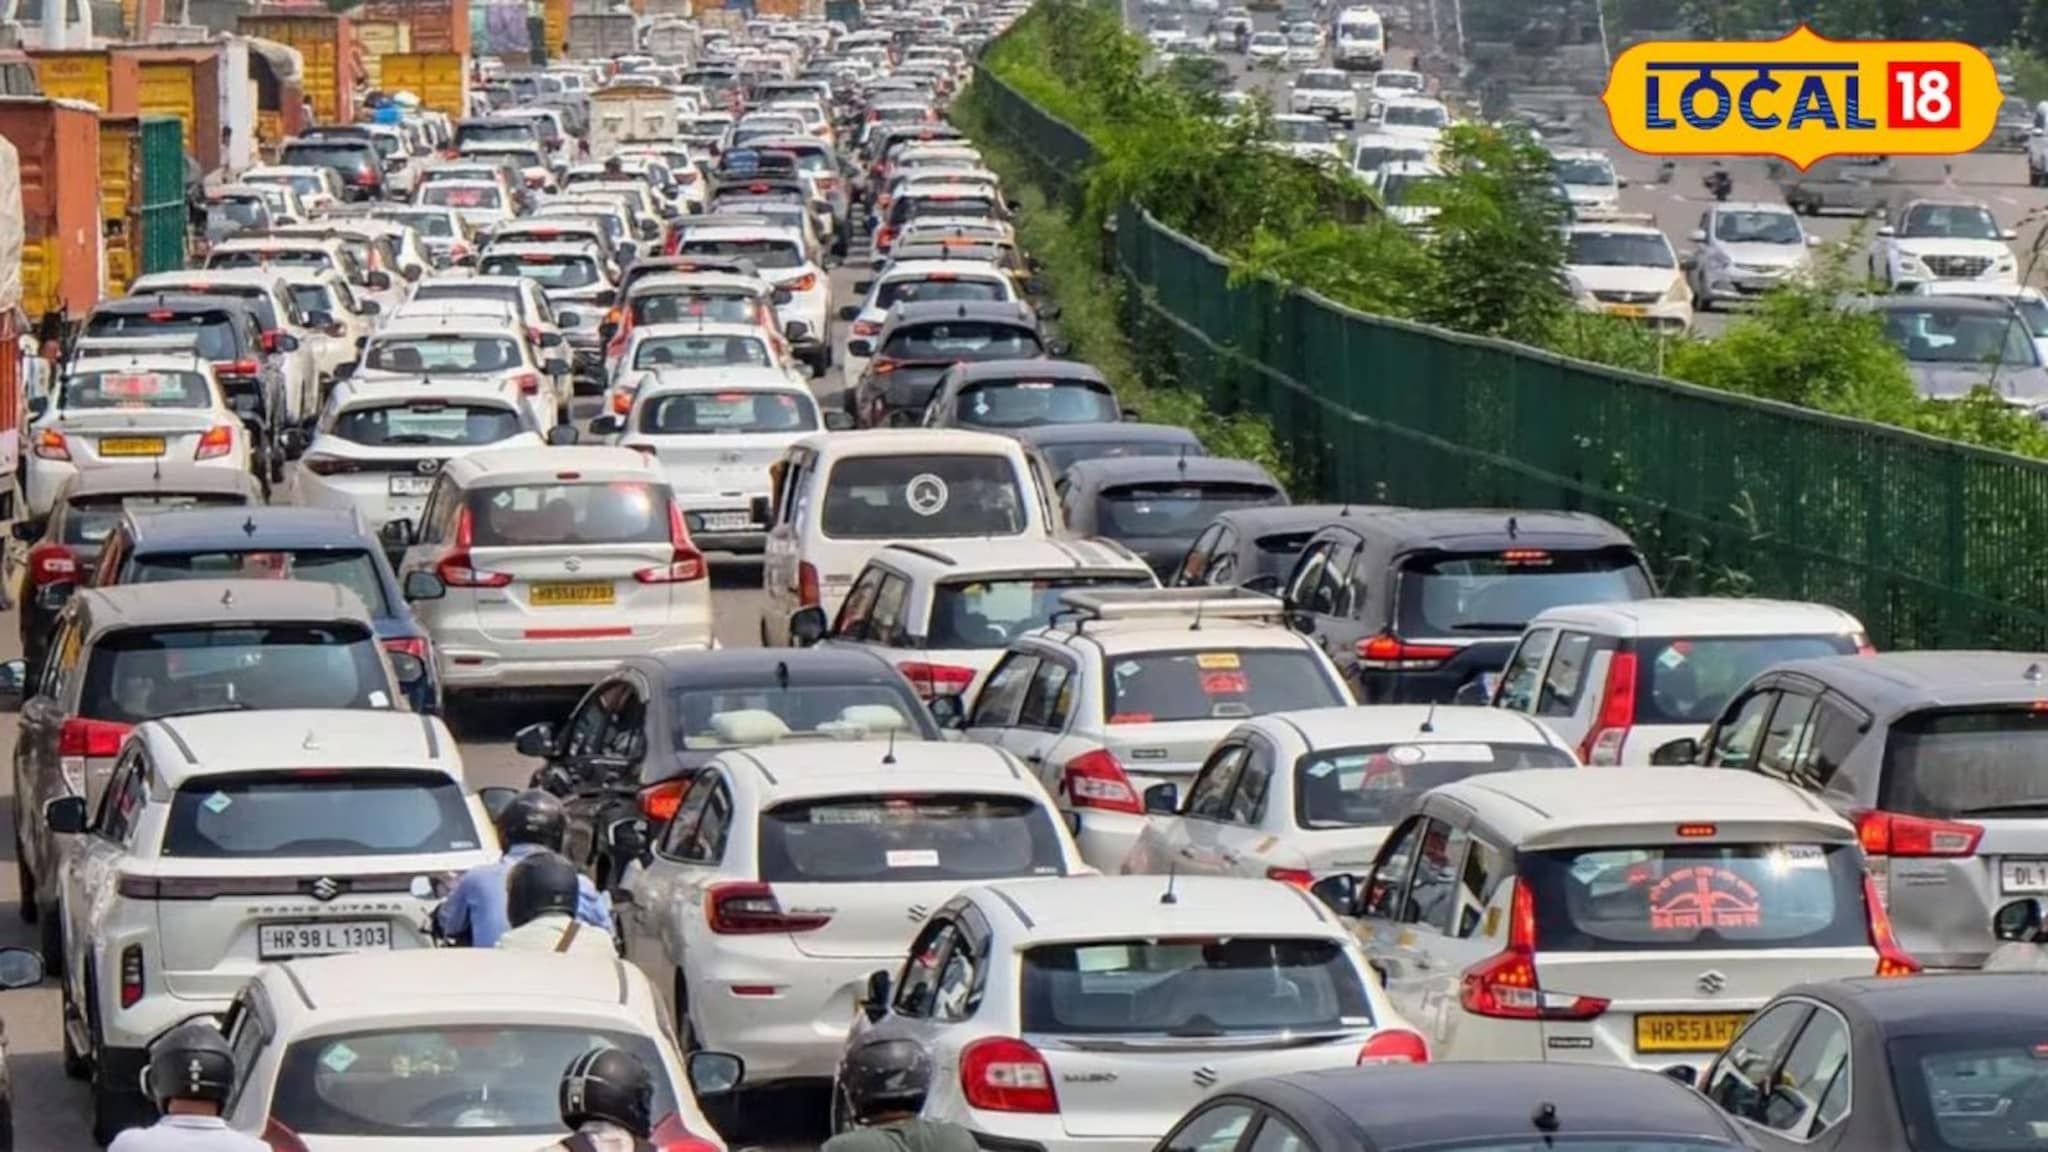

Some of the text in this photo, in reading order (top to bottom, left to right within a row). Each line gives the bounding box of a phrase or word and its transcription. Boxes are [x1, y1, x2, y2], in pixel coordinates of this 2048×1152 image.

[2015, 867, 2036, 886] DL
[274, 927, 387, 948] HR 98 L 1303
